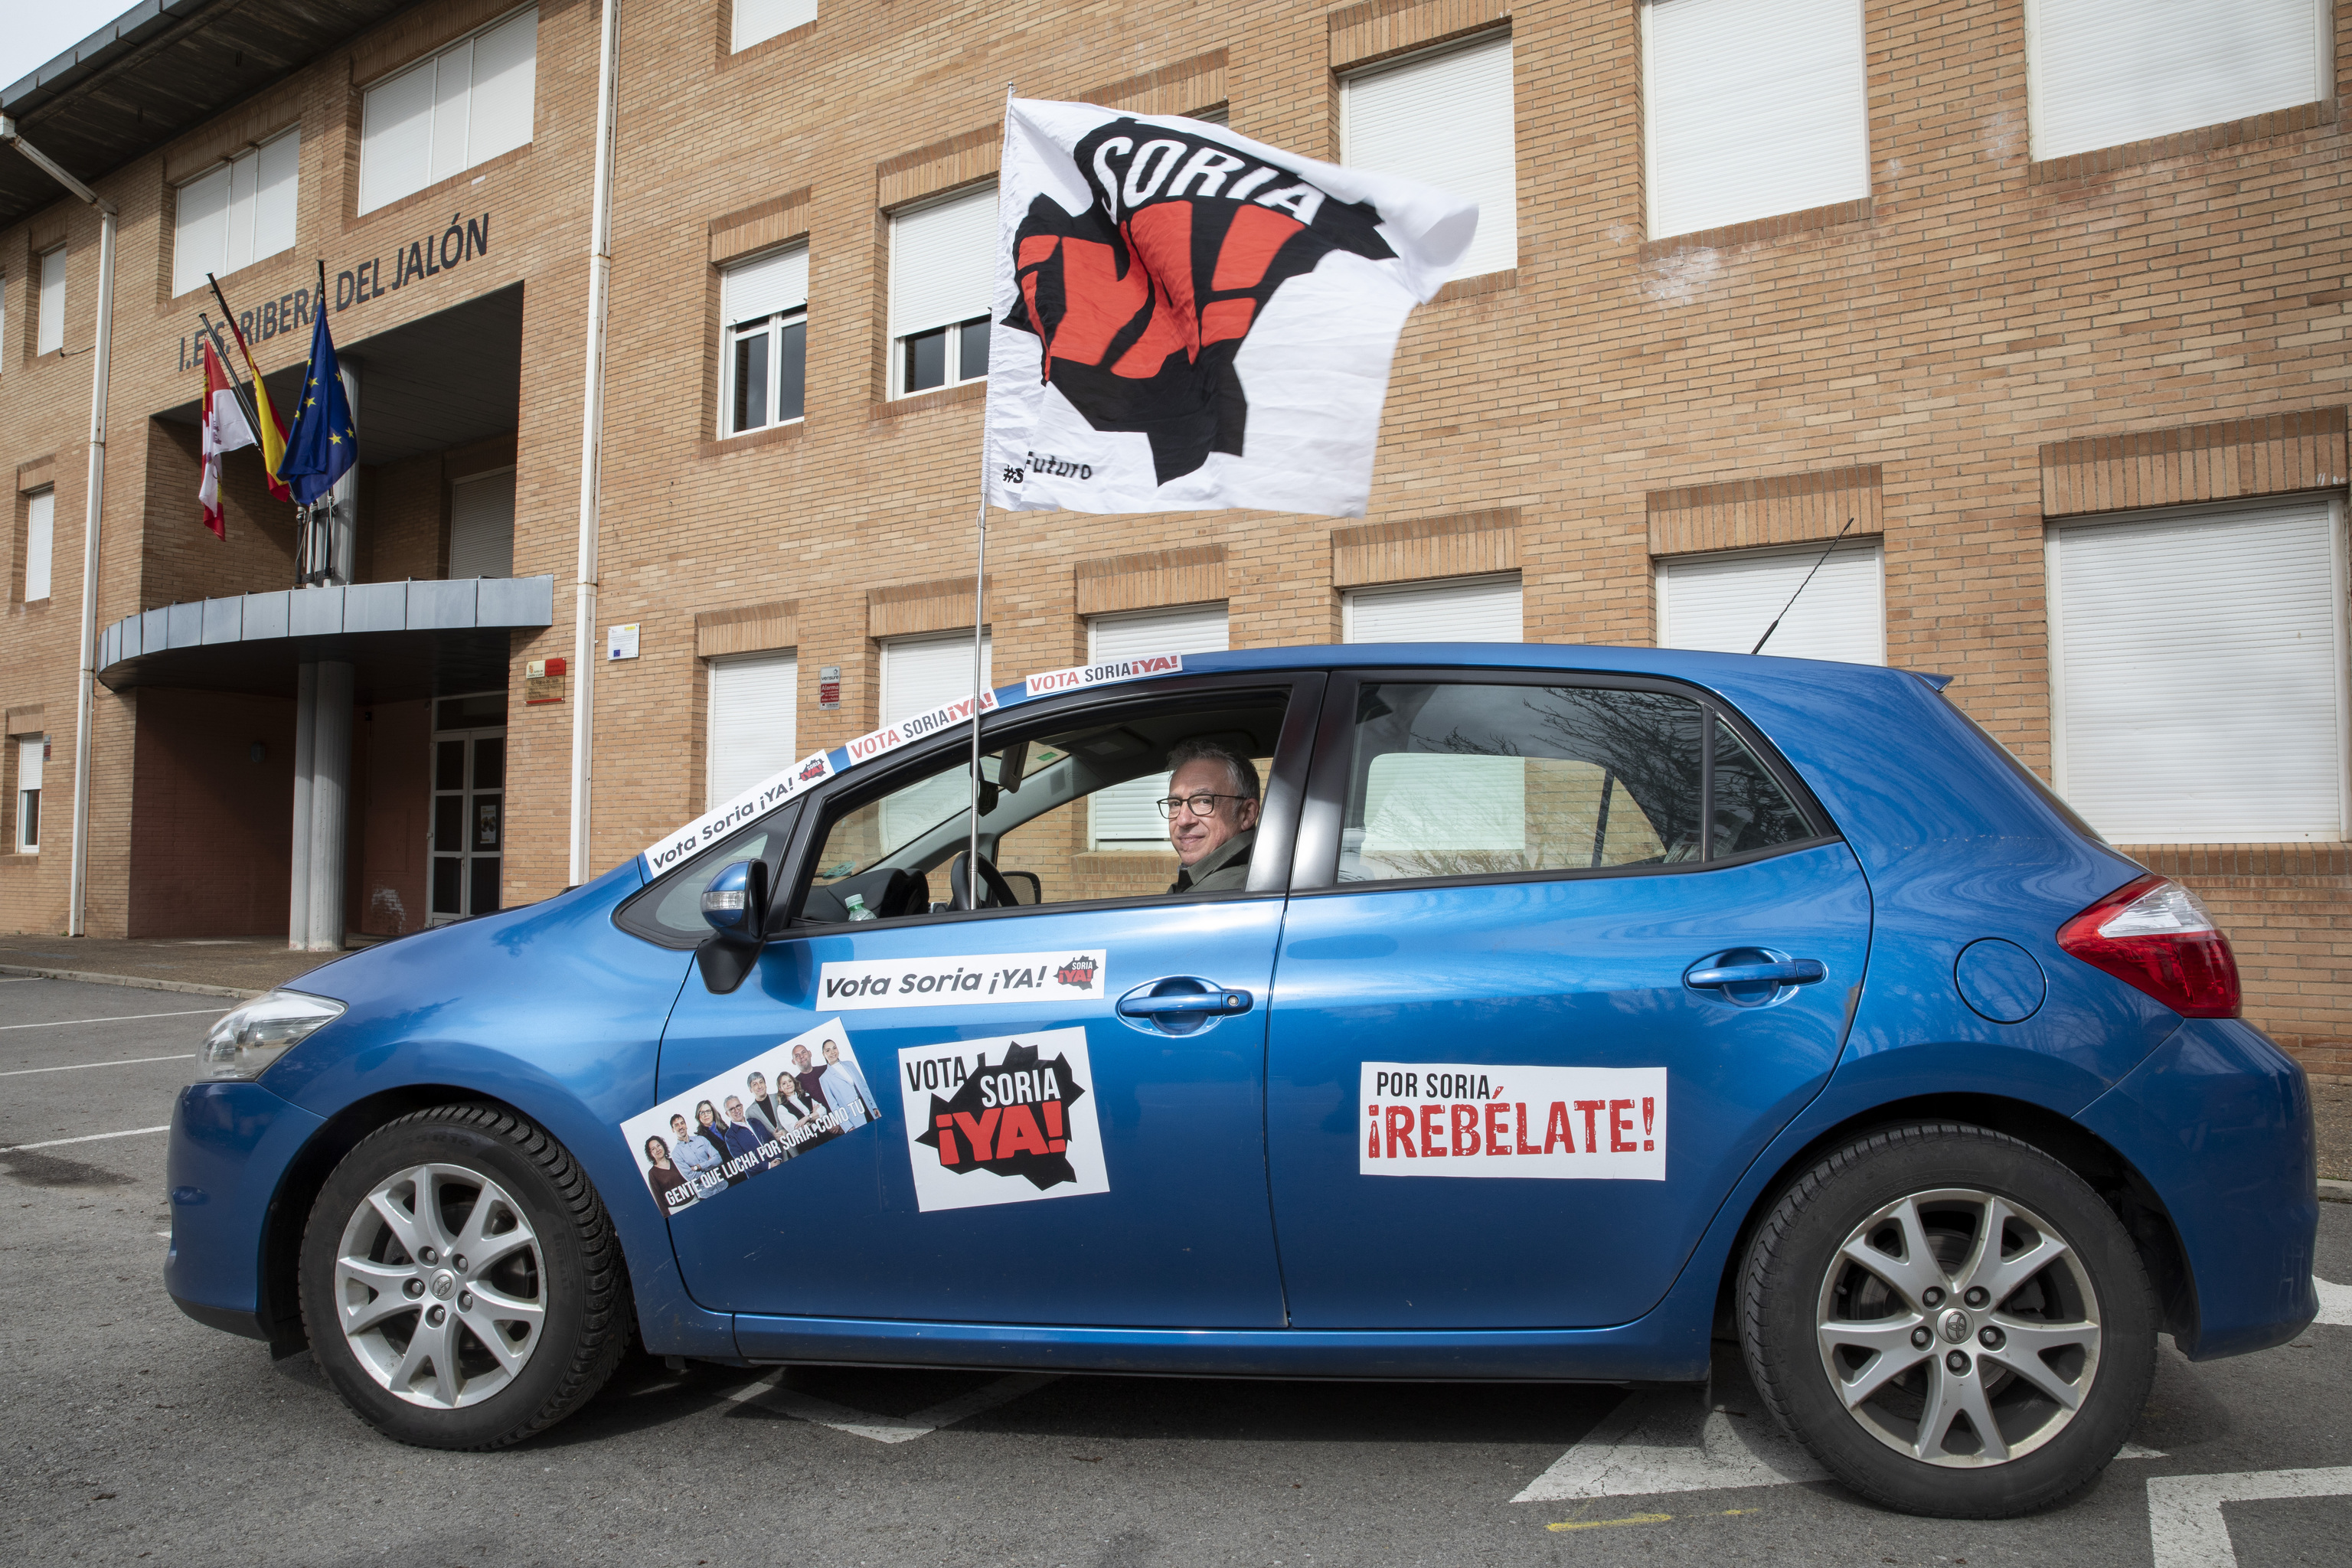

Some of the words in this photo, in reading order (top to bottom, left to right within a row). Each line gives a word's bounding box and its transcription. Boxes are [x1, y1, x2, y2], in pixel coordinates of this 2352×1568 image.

[1093, 136, 1327, 225] SORIA
[336, 257, 385, 312] DEL
[391, 212, 489, 290] JALÓN
[1030, 671, 1080, 691] VOTA
[851, 729, 900, 759] VOTA
[807, 761, 821, 770] SORIA
[652, 835, 697, 869] Vota
[702, 802, 754, 840] Soria
[760, 777, 794, 810] ¡YA!
[826, 974, 891, 998] Vota
[898, 968, 982, 994] Soria
[988, 965, 1047, 994] ¡YA!
[1058, 969, 1093, 983] ¡YA!
[1072, 962, 1093, 970] SORIA
[906, 1056, 967, 1092] VOTA
[980, 1068, 1061, 1108] SORIA
[1377, 1071, 1418, 1098] POR
[1426, 1073, 1491, 1099] SORIA
[936, 1100, 1067, 1165] ¡YA!
[1368, 1086, 1655, 1158] ¡REBÉLATE!
[665, 1177, 703, 1206] GENTE
[700, 1167, 724, 1188] QUE
[720, 1151, 758, 1178] LUCHA
[756, 1142, 782, 1162] POR
[779, 1125, 818, 1151] SORIA,
[815, 1106, 849, 1133] COMO
[847, 1098, 866, 1118] TÚ
